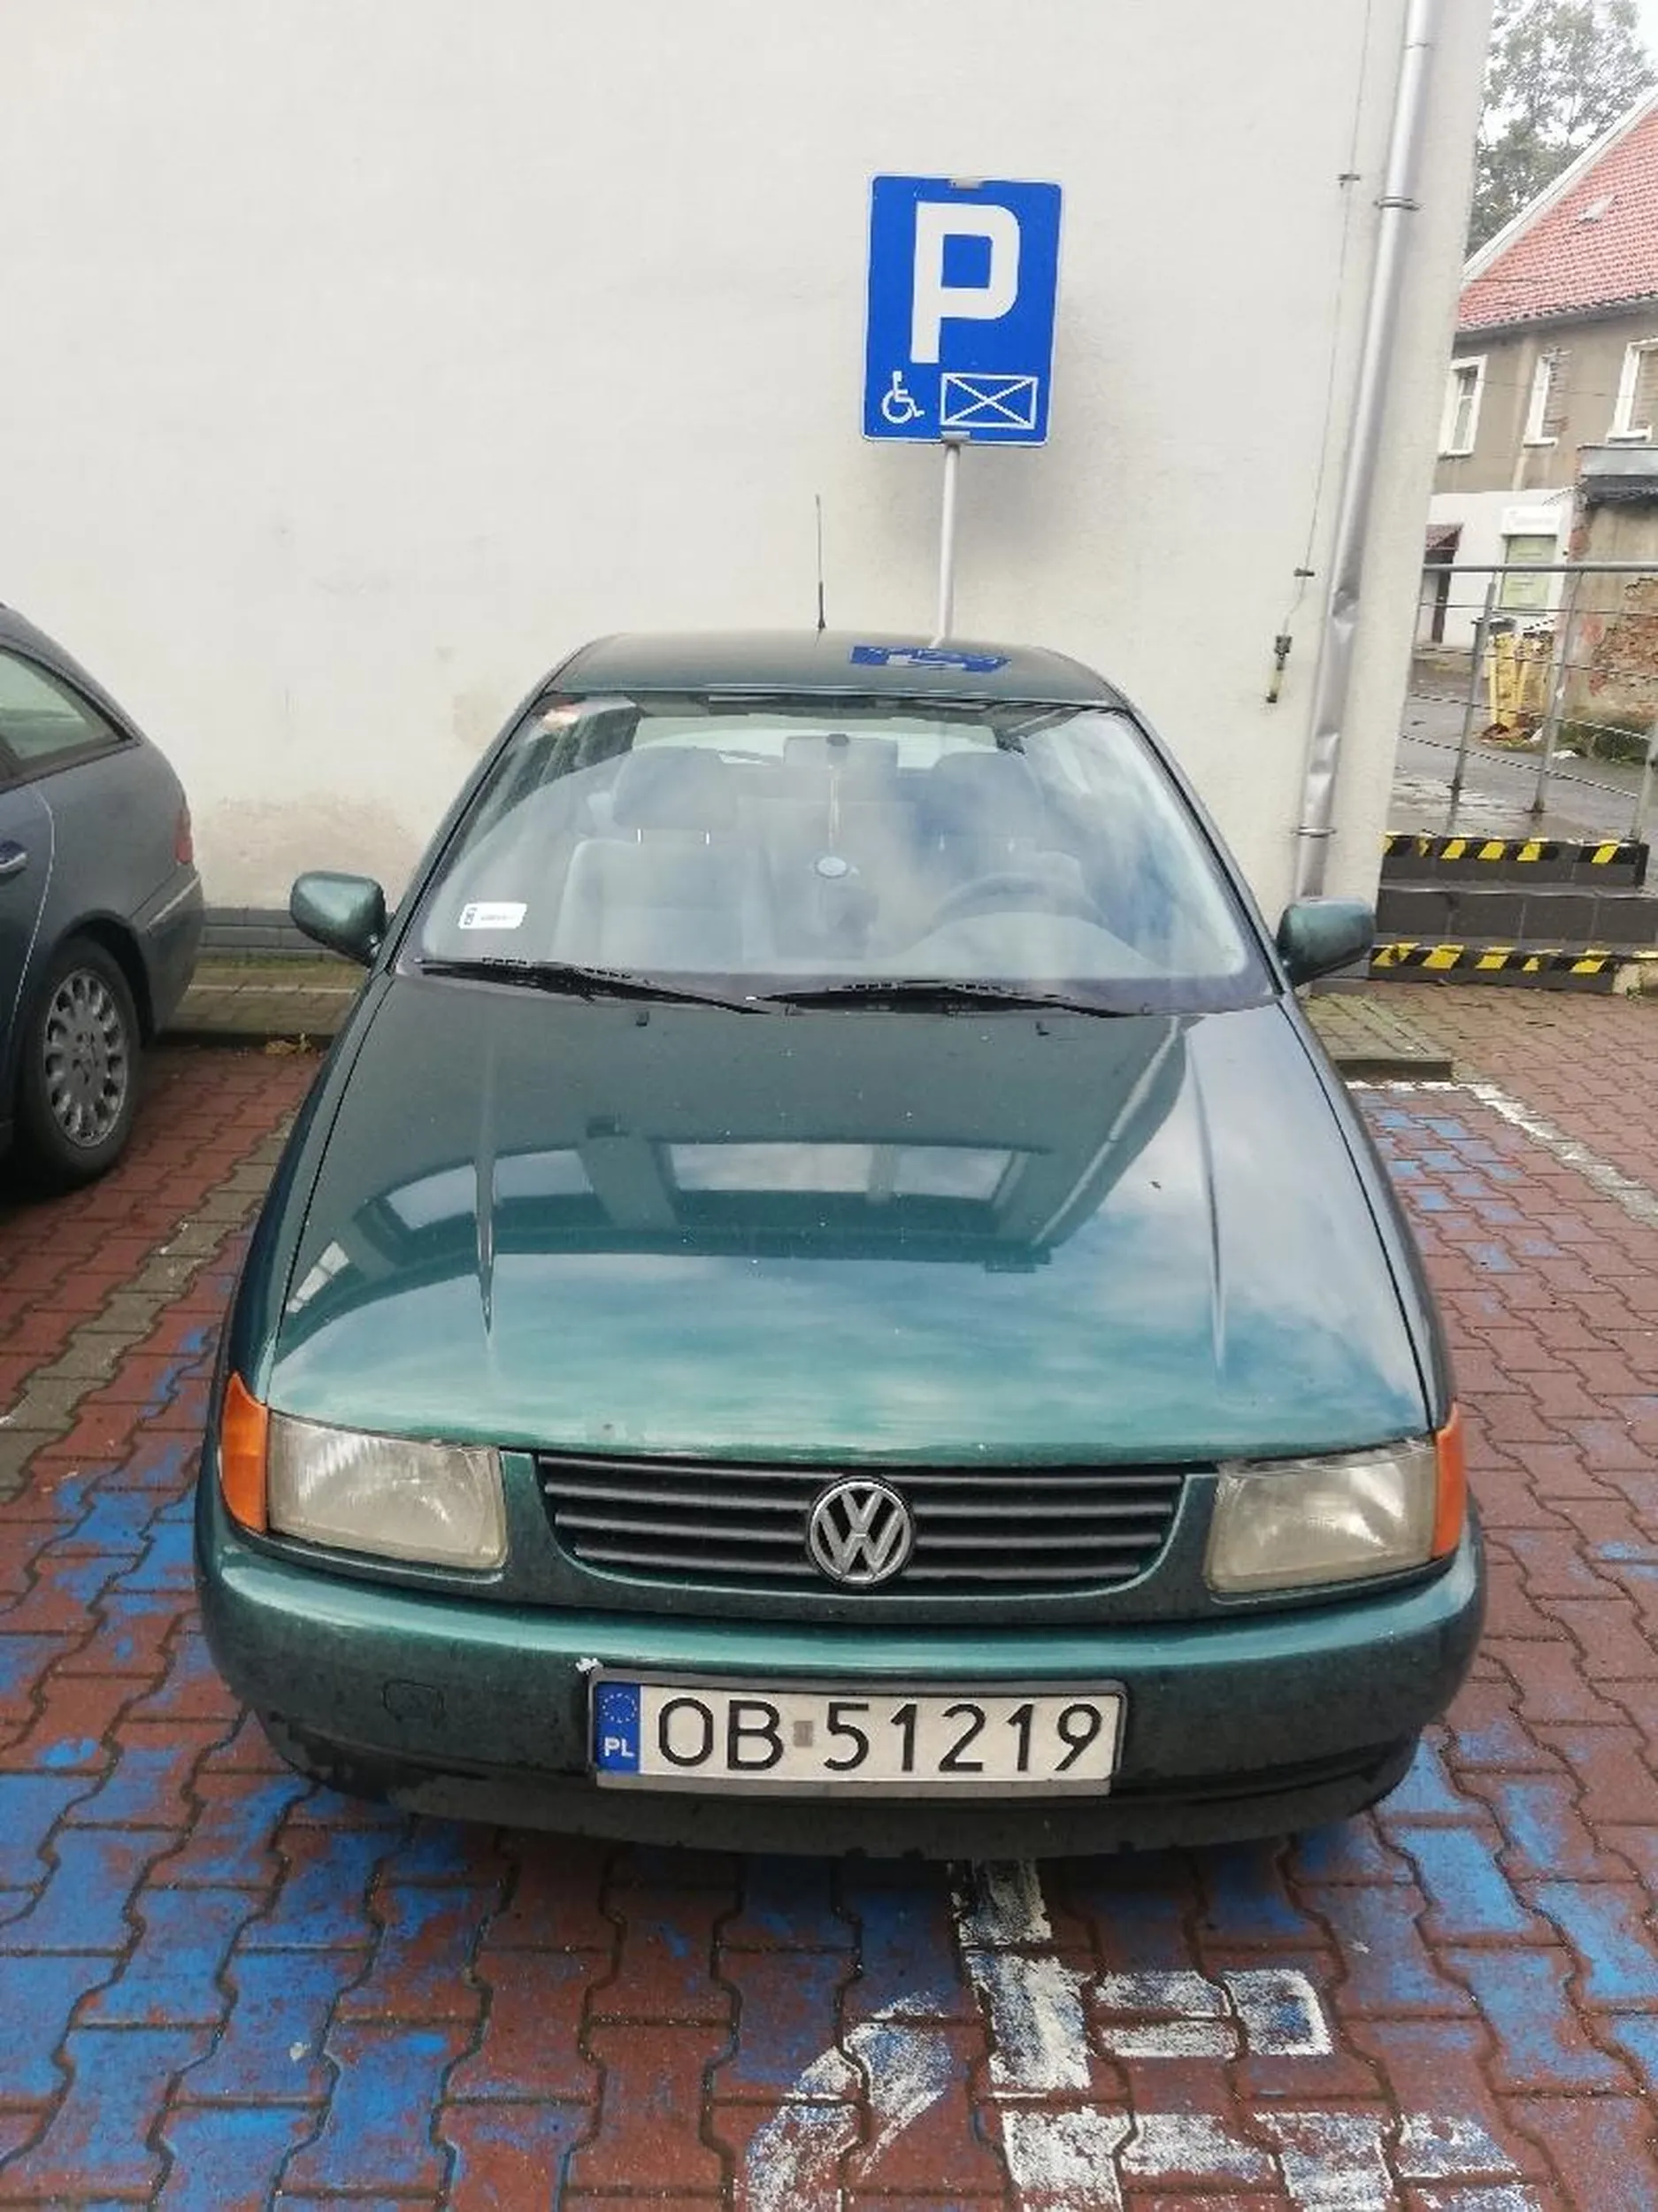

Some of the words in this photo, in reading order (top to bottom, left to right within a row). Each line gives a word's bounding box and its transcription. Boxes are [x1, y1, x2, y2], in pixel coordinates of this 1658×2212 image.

[910, 201, 1020, 364] P
[812, 1483, 910, 1582] VW
[603, 1736, 634, 1757] PL
[658, 1697, 784, 1770] OB
[824, 1701, 1102, 1771] 51219
